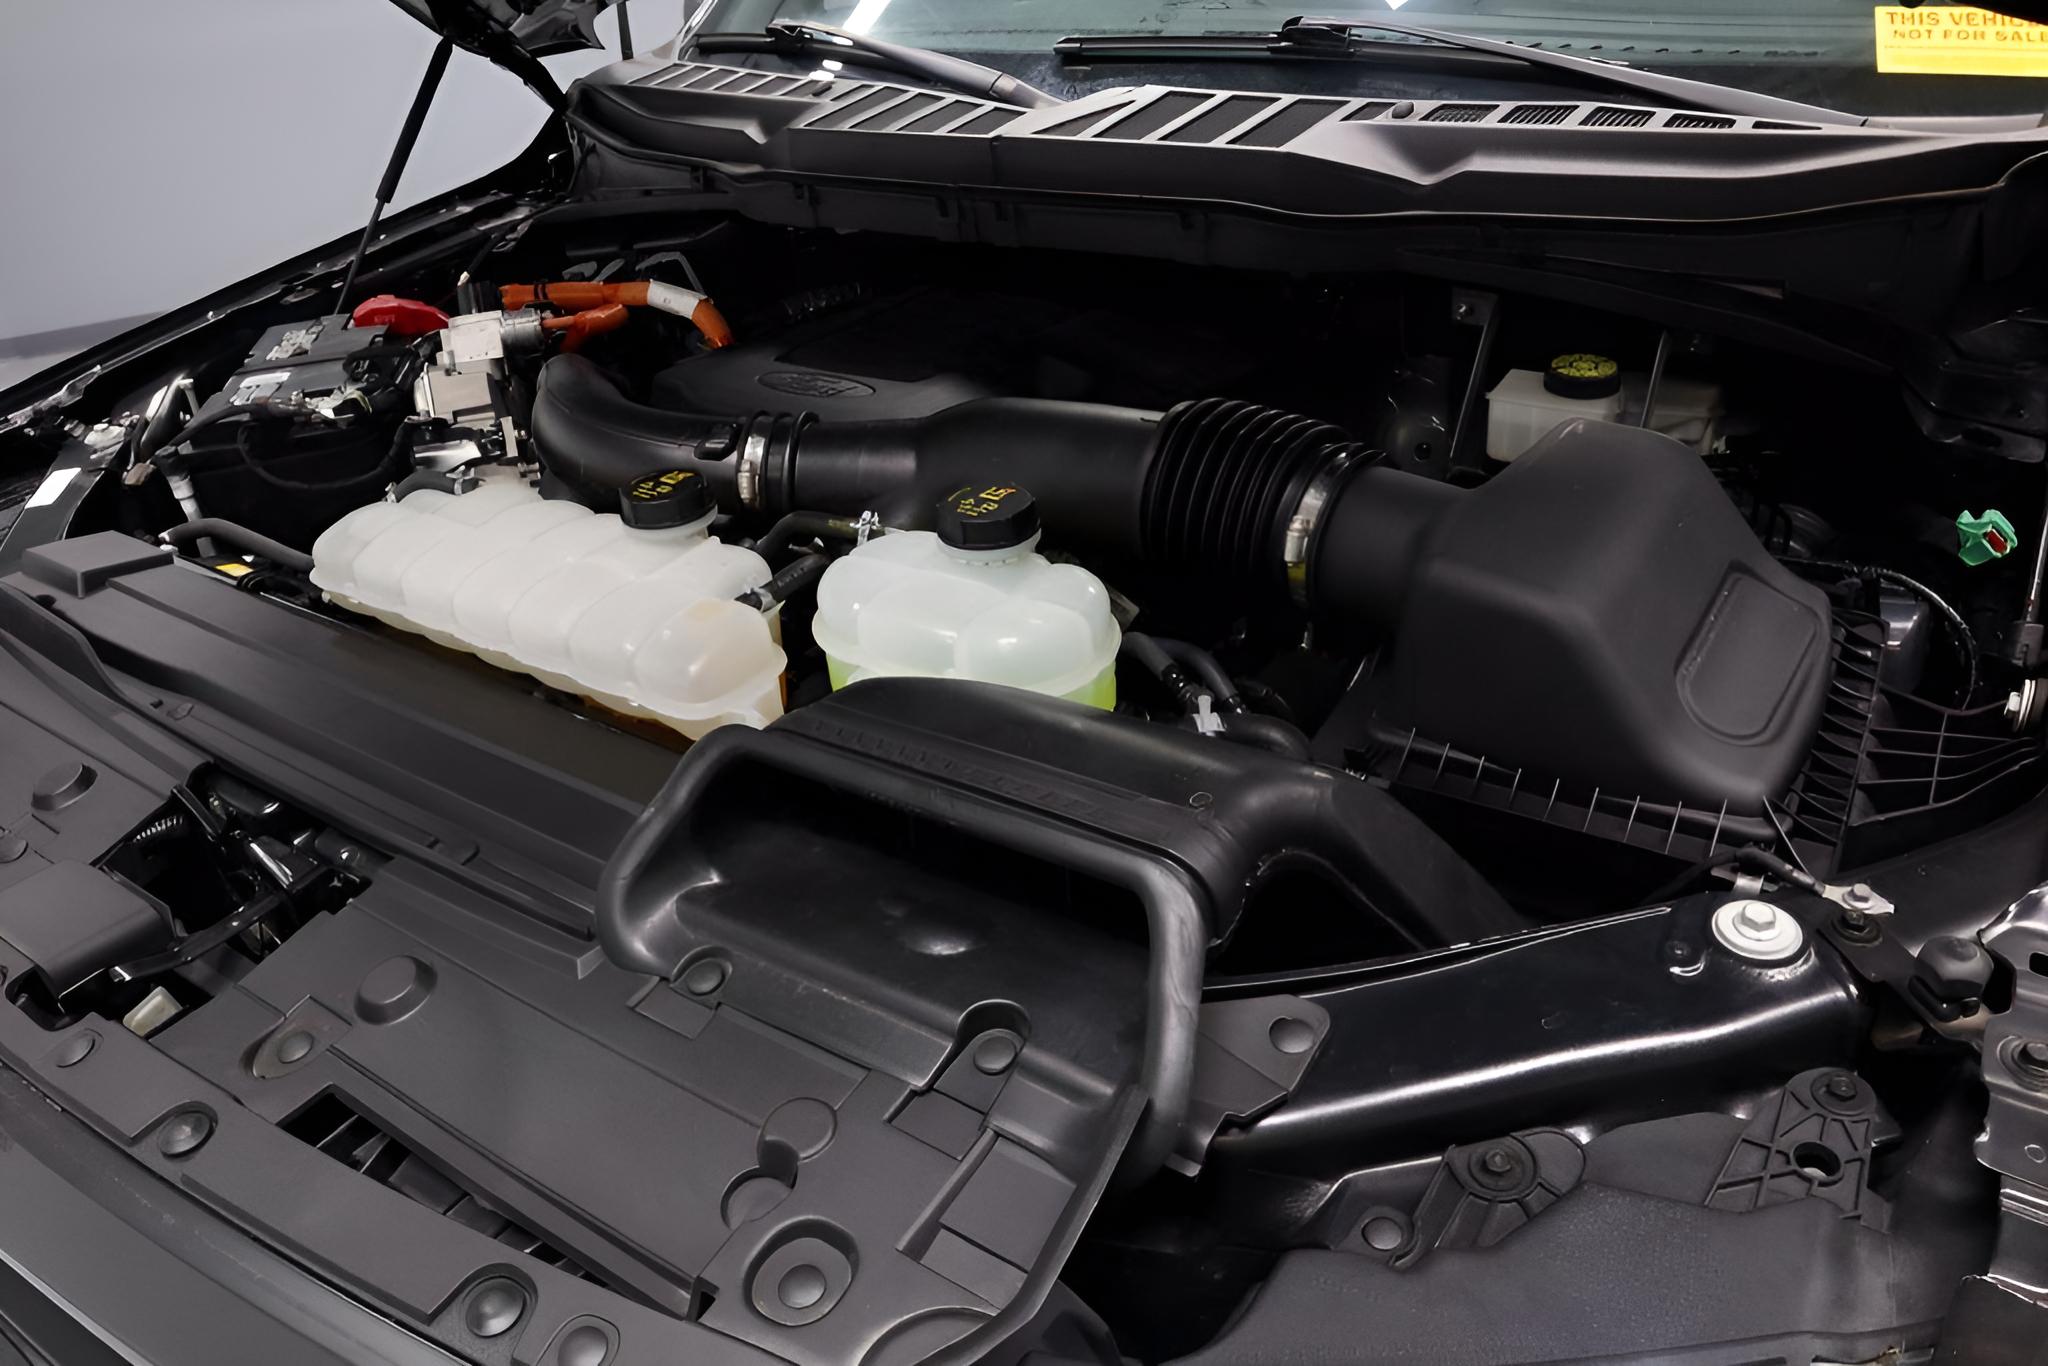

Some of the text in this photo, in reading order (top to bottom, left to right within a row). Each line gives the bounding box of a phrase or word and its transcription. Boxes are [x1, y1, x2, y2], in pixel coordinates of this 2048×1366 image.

[1886, 11, 2039, 28] THIS VEHIC
[1893, 29, 1933, 40] NOT
[1943, 29, 1985, 41] FOR
